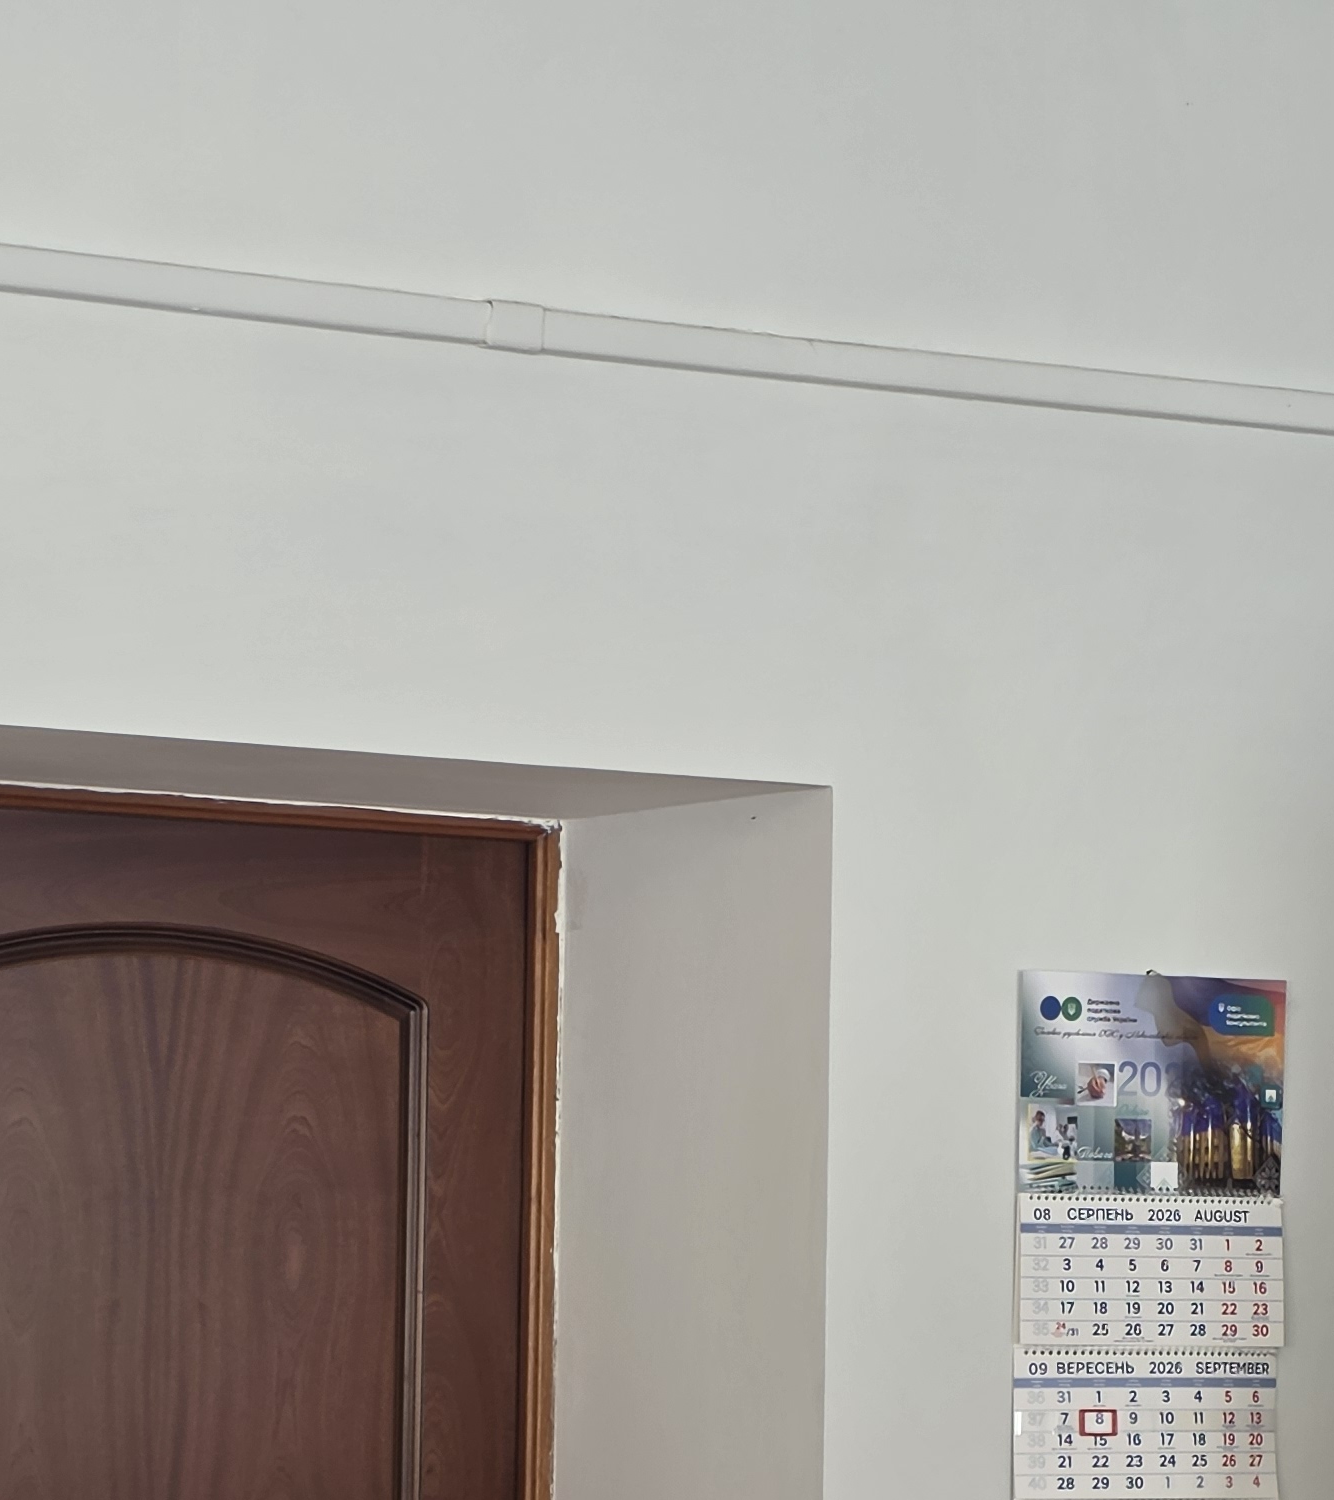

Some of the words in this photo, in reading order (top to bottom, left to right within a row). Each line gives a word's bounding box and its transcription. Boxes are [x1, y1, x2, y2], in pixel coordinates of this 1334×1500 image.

[1034, 1208, 1050, 1220] 08
[1067, 1208, 1133, 1221] СЕРПЕНЬ
[1148, 1209, 1181, 1221] 2026
[1195, 1210, 1249, 1223] AUGUST
[1029, 1363, 1047, 1375] 09
[1057, 1361, 1134, 1374] ВЕРЕСЕНЬ
[1149, 1362, 1182, 1374] 2026
[1196, 1362, 1269, 1375] SEPTEMBER
[1058, 1456, 1071, 1468] 21
[1092, 1455, 1109, 1468] 22
[1126, 1455, 1142, 1467] 23
[1160, 1455, 1176, 1467] 24
[1192, 1455, 1207, 1467] 25
[1222, 1455, 1236, 1467] 26
[1249, 1455, 1262, 1466] 27
